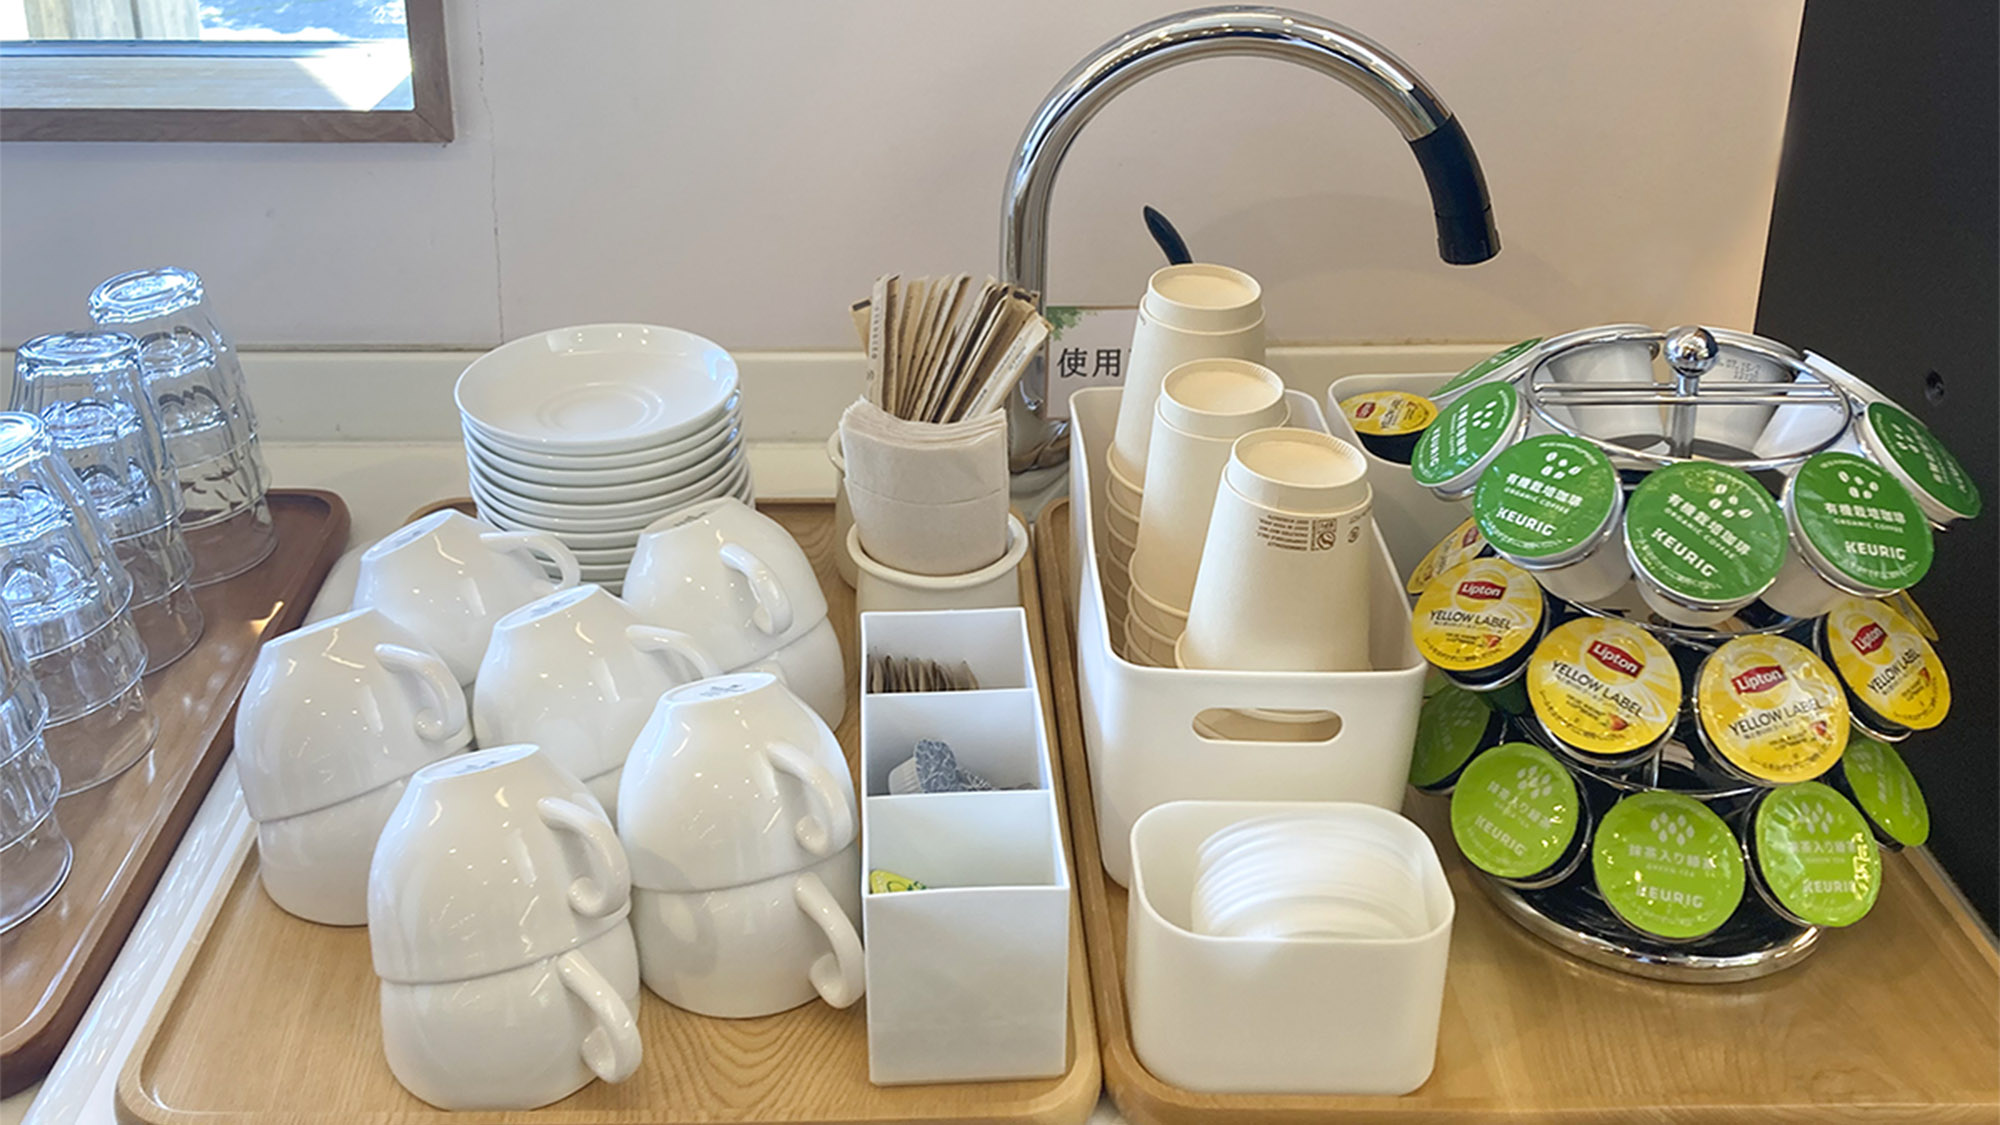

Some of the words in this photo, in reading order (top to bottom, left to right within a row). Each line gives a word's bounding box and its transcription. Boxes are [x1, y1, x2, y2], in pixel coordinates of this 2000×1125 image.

[1057, 347, 1131, 378] 使用
[1495, 507, 1557, 536] KEURIG
[1651, 528, 1719, 577] KEURIG
[1845, 541, 1907, 560] KEURIG
[1461, 583, 1501, 597] Lipton
[1430, 610, 1475, 622] YELLOW
[1475, 615, 1512, 630] LABEL
[1854, 627, 1884, 651] Lipton
[1593, 644, 1639, 674] Lipton
[1551, 660, 1604, 692] YELLOW
[1602, 687, 1644, 718] LABEL
[1735, 669, 1783, 691] Lipton
[1867, 660, 1901, 694] YELLOW
[1728, 709, 1782, 736] YELLOW
[1785, 699, 1824, 718] LABEL
[1475, 815, 1528, 857] KEURIG
[1635, 883, 1704, 908] KEURIG
